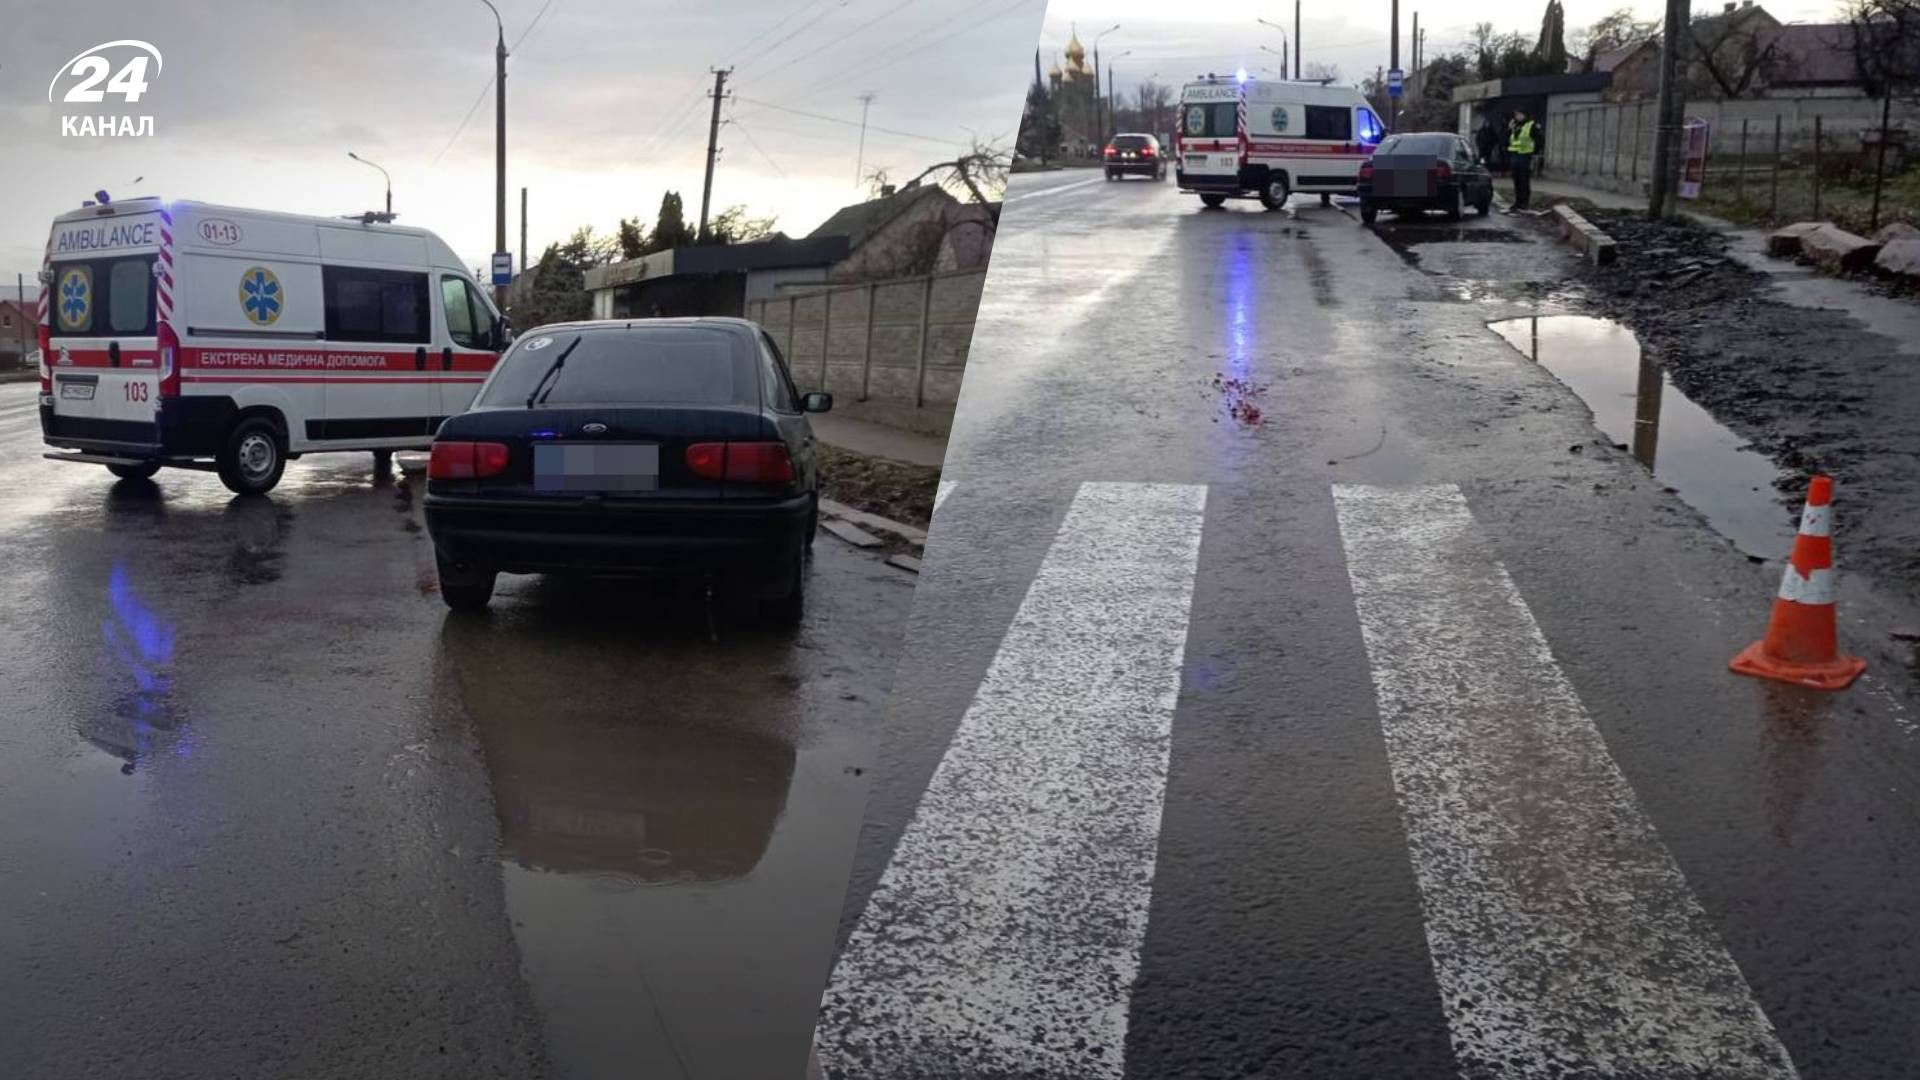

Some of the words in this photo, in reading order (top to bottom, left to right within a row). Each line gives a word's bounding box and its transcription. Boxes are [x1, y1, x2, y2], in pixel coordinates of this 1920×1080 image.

[1186, 87, 1238, 99] AMBULANCE
[58, 223, 155, 250] AMBULANCE
[203, 223, 239, 241] 01-13
[201, 351, 265, 366] ЕКСТРЕНА
[268, 353, 324, 367] МЕДИЧНА
[326, 355, 387, 367] ДОПОМОГА
[123, 381, 148, 402] 103
